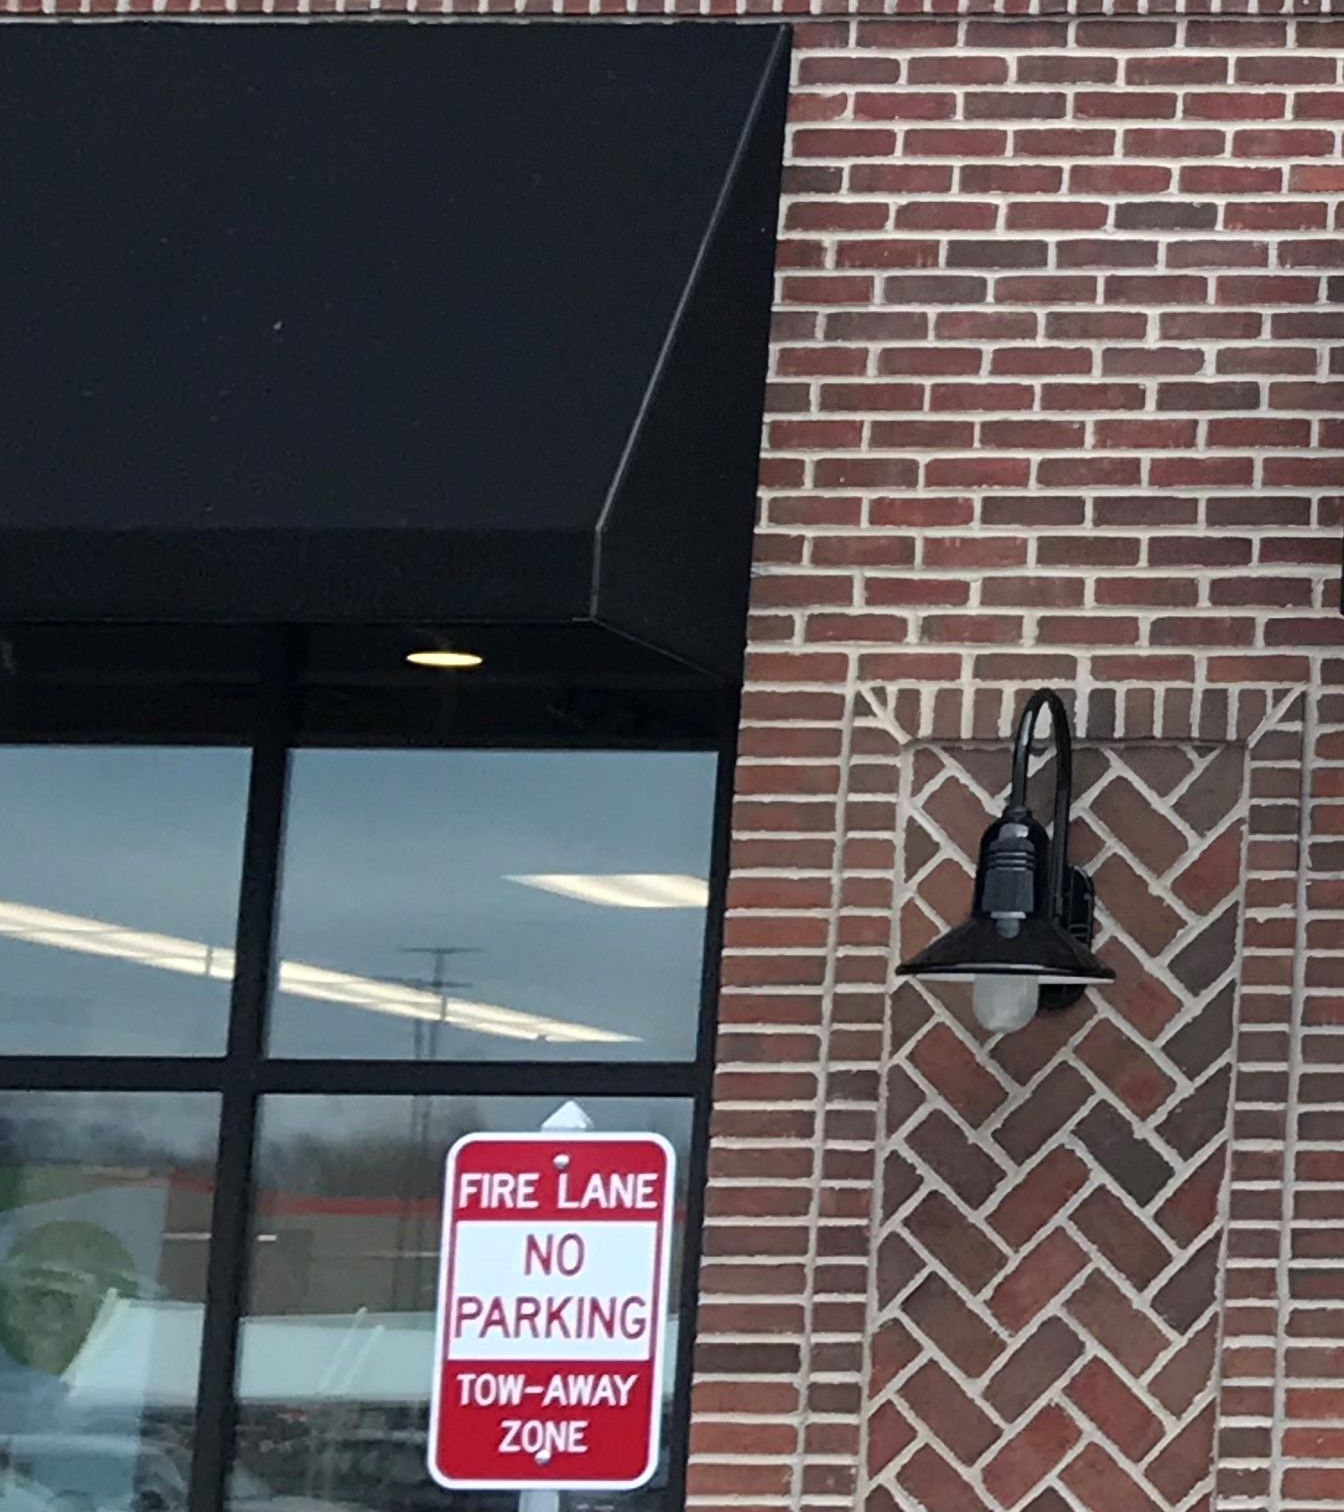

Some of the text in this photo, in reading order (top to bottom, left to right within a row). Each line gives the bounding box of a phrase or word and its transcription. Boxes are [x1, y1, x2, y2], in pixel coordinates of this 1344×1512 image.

[458, 1171, 659, 1210] FIRE LANE
[523, 1232, 586, 1277] NO
[453, 1294, 648, 1340] PARKING
[455, 1372, 640, 1407] TOW-AWAY
[498, 1419, 590, 1454] ZONE
